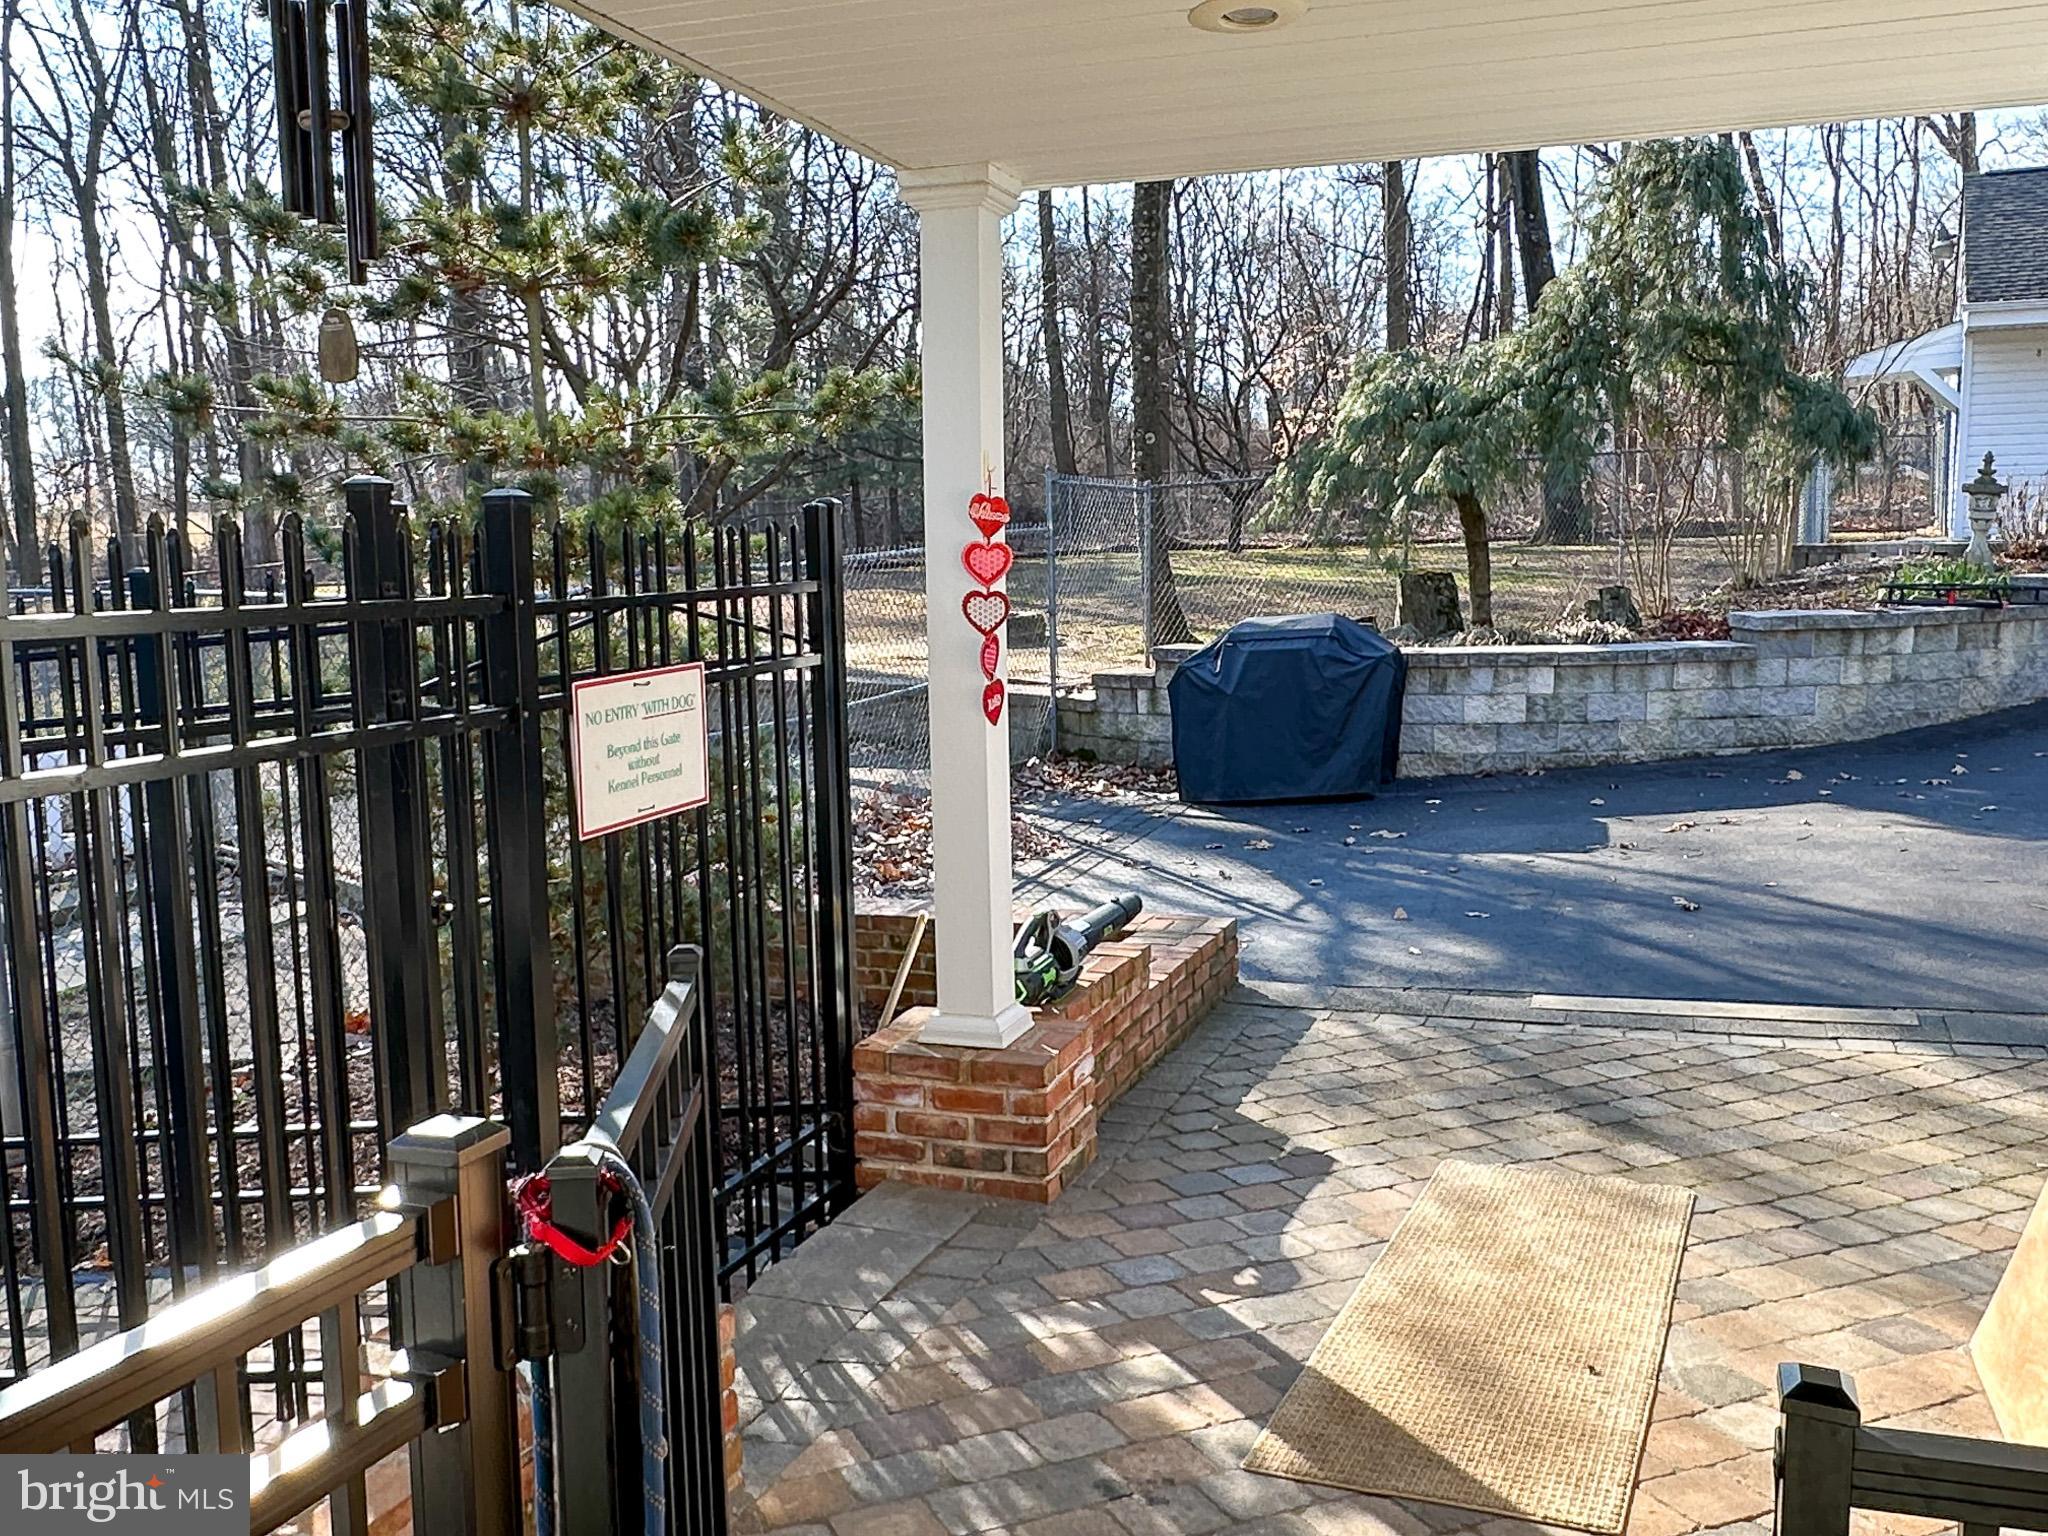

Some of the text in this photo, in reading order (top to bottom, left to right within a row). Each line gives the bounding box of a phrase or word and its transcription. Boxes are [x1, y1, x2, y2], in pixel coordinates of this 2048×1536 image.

[585, 710, 602, 728] NO
[605, 704, 639, 724] ENTRY
[607, 732, 681, 759] Beyond this Gate
[628, 753, 660, 771] without
[608, 763, 683, 794] Kennel Personnel
